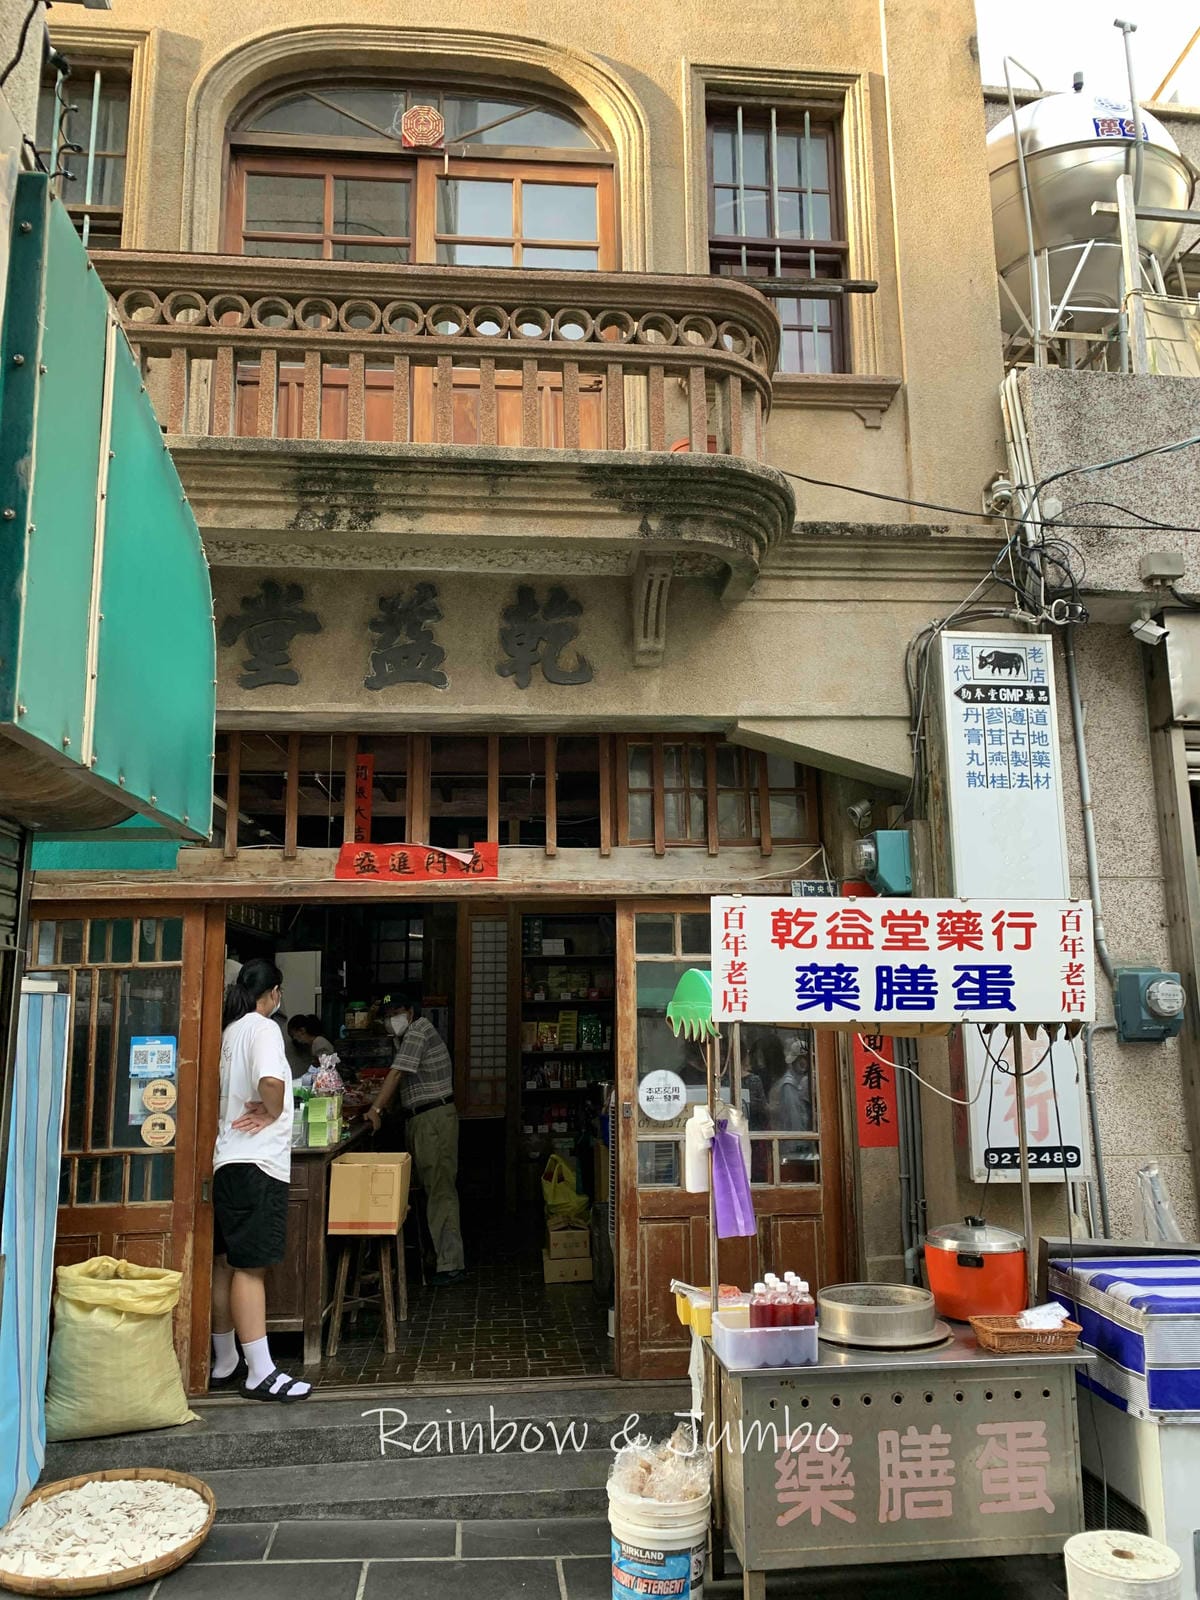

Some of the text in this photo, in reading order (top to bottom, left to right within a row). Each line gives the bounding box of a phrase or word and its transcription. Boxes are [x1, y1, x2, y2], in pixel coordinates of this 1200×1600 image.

[1027, 647, 1045, 684] 老店
[963, 707, 985, 788] 丹膏丸散
[985, 707, 1008, 789] 參茸燕桂
[1008, 707, 1030, 789] 遵古製法
[1030, 708, 1052, 789] 道地藥材
[721, 905, 748, 1013] 百年老店
[770, 907, 1037, 951] 乾益堂藥行
[1058, 908, 1085, 1014] 百年老店
[795, 962, 1017, 1012] 藥膳蛋
[775, 1420, 1055, 1526] 藥膳蛋
[621, 1543, 664, 1561] KIRKLAND
[636, 1577, 686, 1595] DETERGENT
